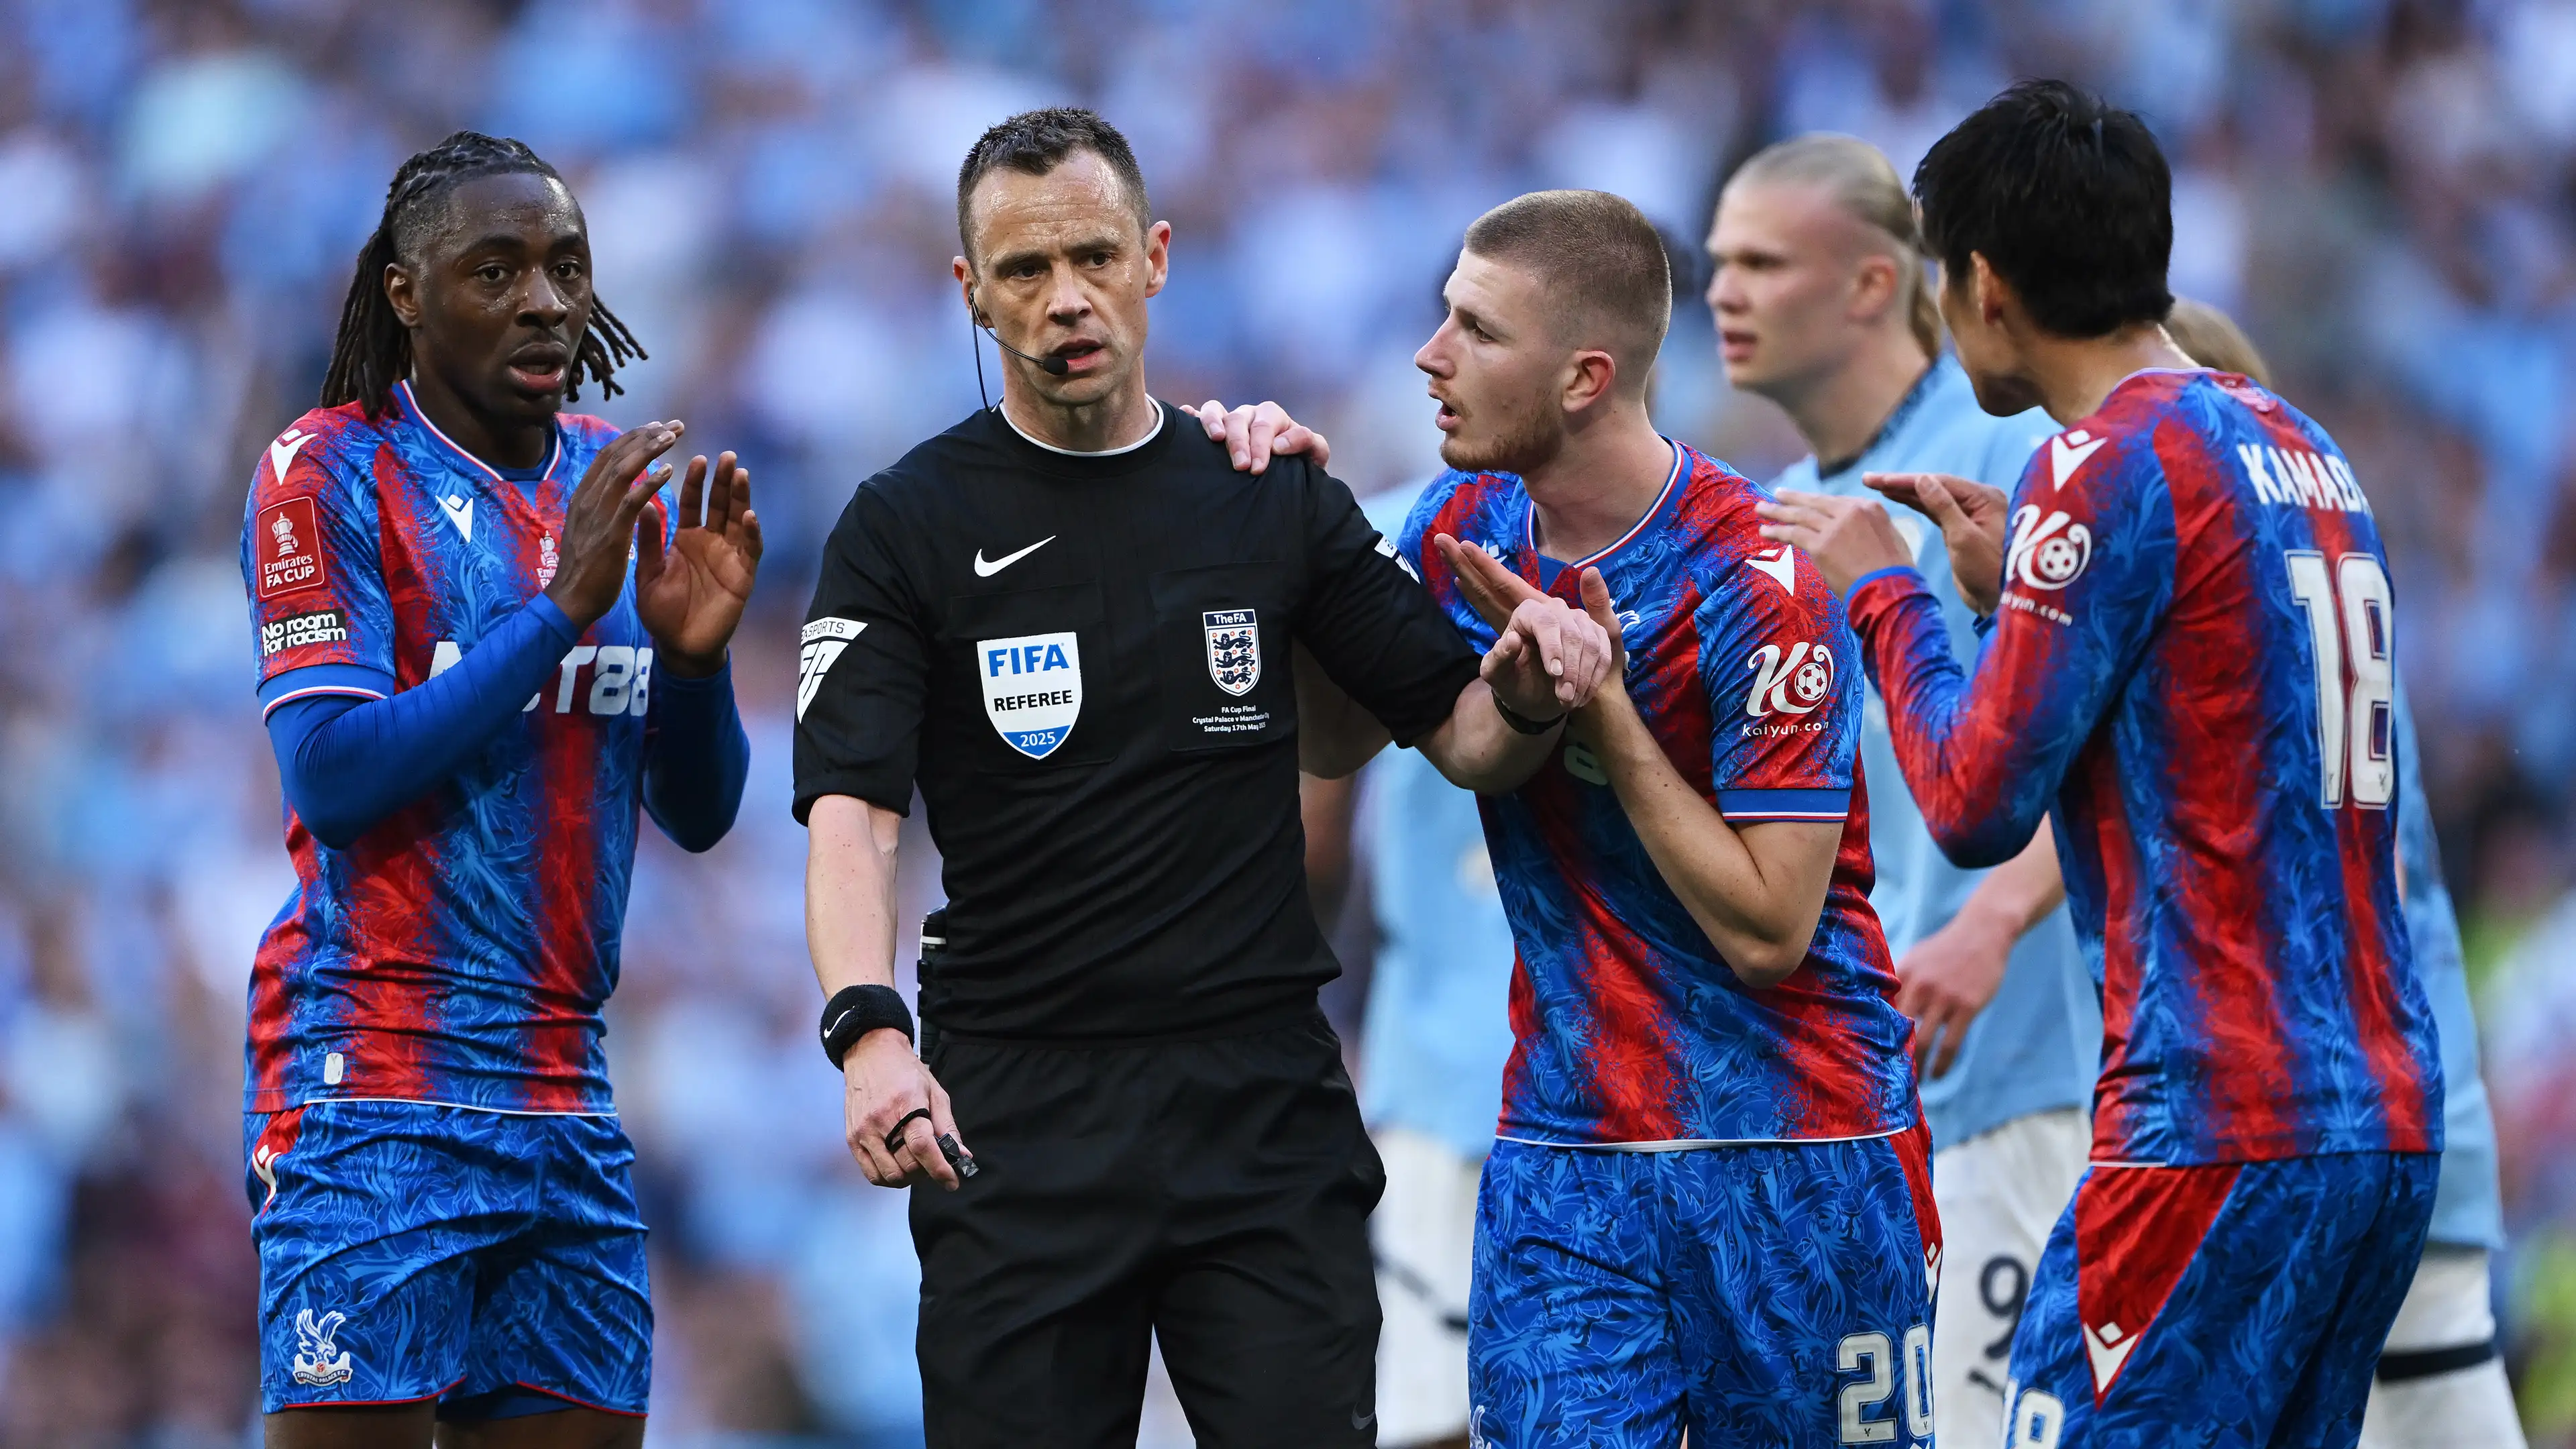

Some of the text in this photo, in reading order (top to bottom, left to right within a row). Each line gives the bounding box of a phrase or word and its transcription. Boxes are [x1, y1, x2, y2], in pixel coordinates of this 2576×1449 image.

[264, 554, 313, 575] Emirates
[266, 566, 315, 588] FA CUP
[262, 613, 337, 641] No room
[808, 621, 845, 637] SPORTS
[263, 627, 347, 656] for racism
[987, 643, 1070, 678] FIFA
[2285, 549, 2394, 809] 18
[994, 690, 1073, 712] REFEREE
[1192, 716, 1214, 724] Crystal
[1020, 731, 1056, 747] 2025
[1981, 1255, 2029, 1361] 9
[297, 1372, 319, 1382] CRYSTAL
[318, 1373, 337, 1383] PALACE
[1837, 1322, 1934, 1445] 20
